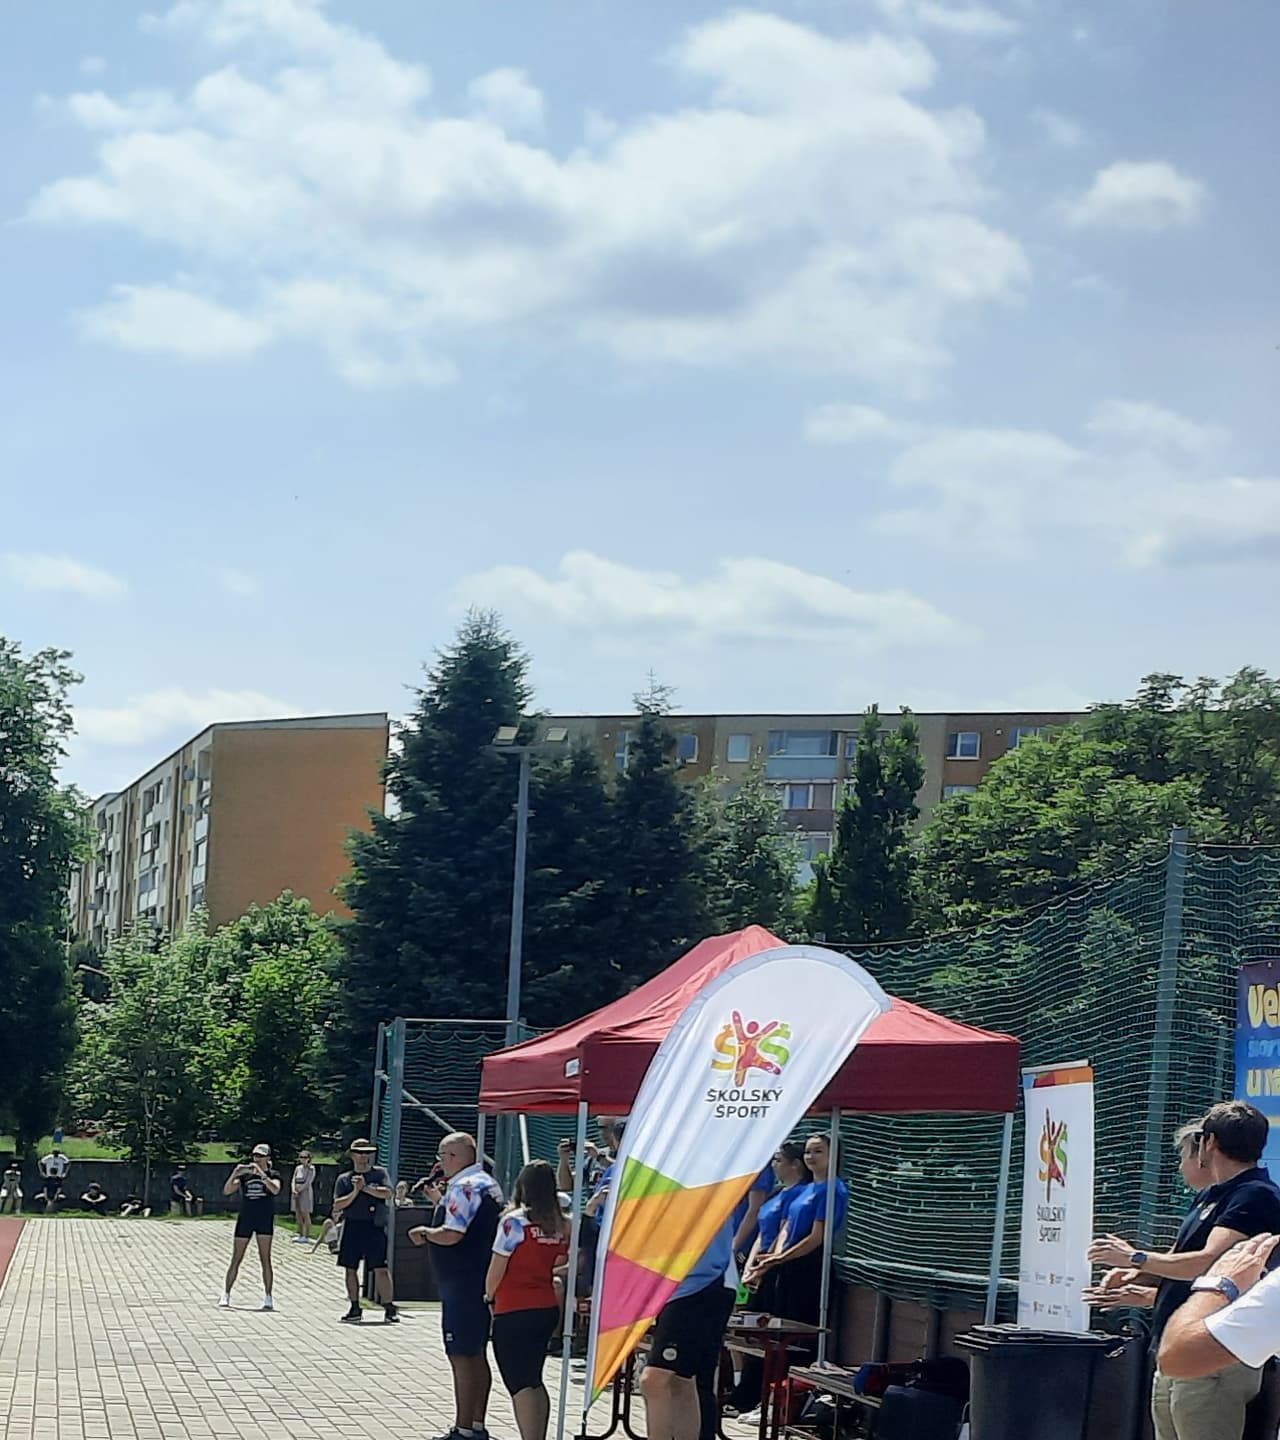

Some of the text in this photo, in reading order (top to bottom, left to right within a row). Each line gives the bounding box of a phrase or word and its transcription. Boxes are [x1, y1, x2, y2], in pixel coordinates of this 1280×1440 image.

[1247, 982, 1280, 1028] Ve
[704, 1087, 783, 1103] ŠKOLSKÝ
[715, 1104, 771, 1119] ŠPORT
